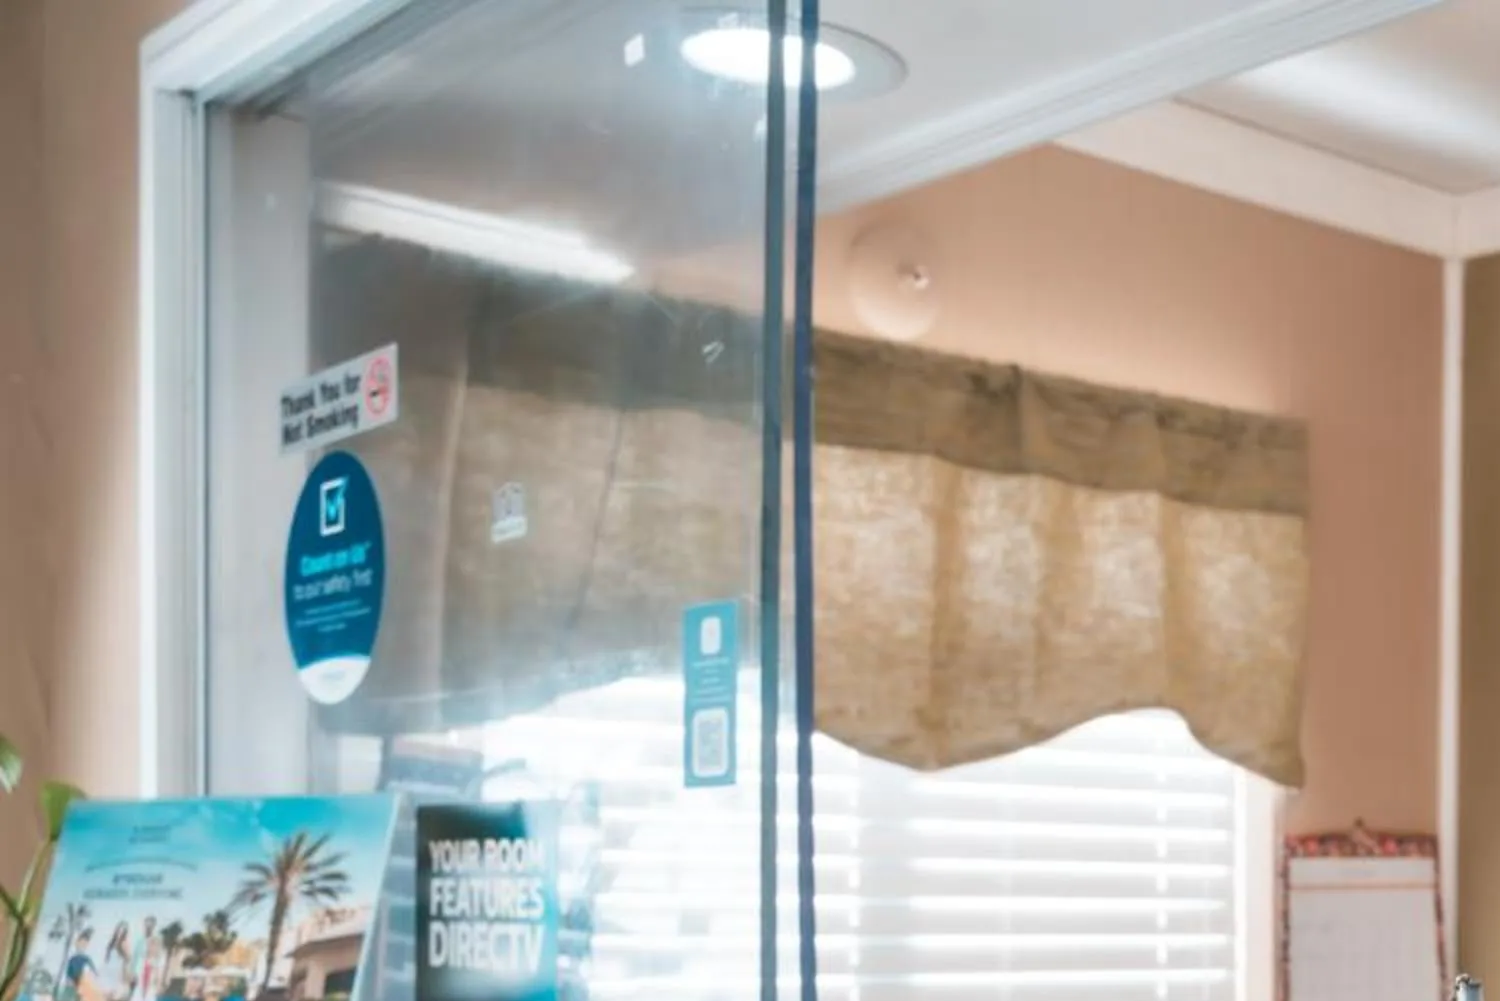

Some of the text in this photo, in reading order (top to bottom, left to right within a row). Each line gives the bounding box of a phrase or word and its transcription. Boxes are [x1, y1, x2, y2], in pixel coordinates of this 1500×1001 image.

[281, 387, 315, 418] Thank
[319, 381, 340, 403] You
[283, 404, 359, 446] Not Smoking
[428, 837, 544, 873] YOUR ROOM
[428, 875, 545, 921] FEATURES
[428, 920, 545, 978] DIRECTV
